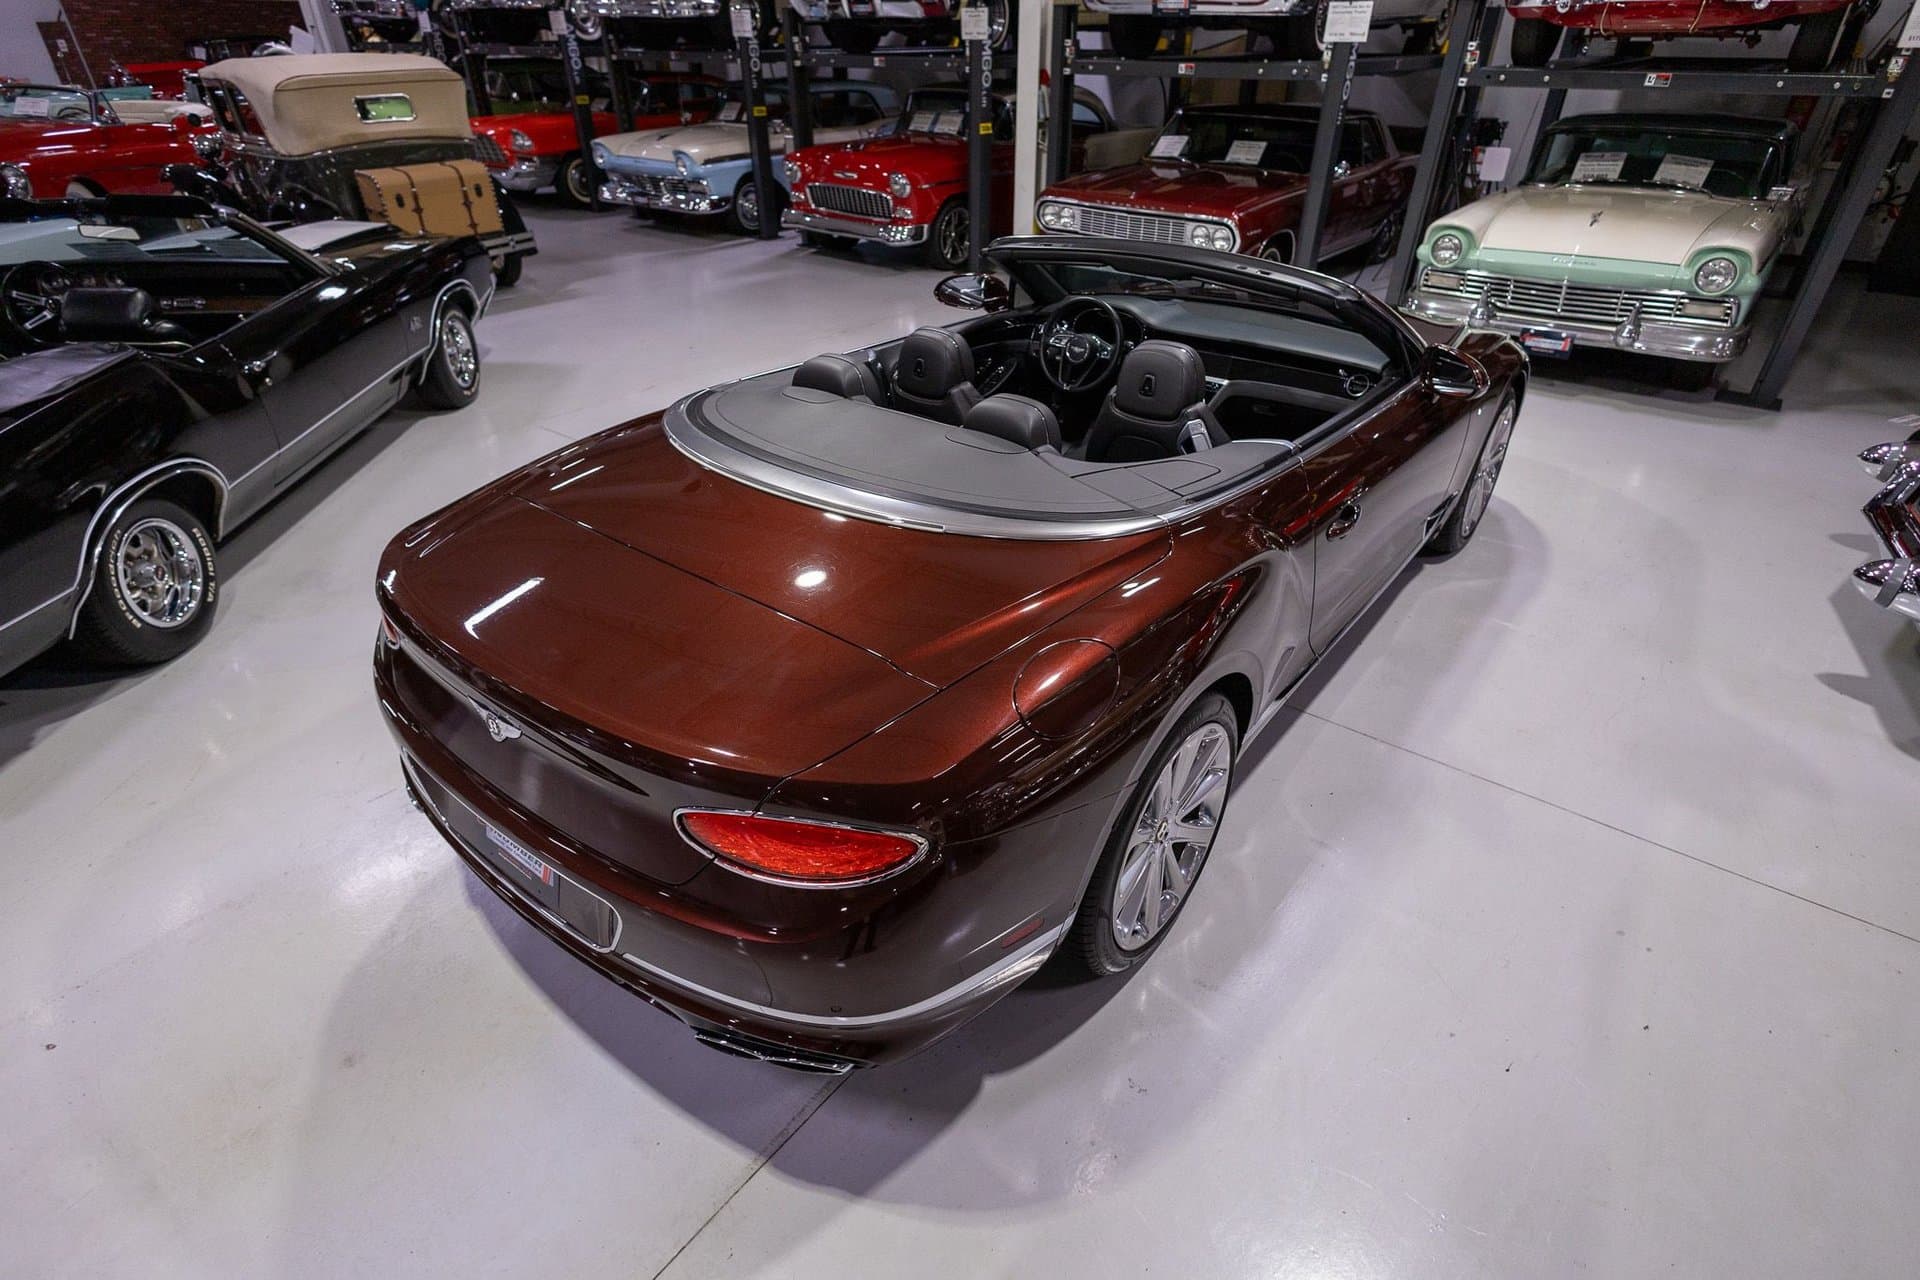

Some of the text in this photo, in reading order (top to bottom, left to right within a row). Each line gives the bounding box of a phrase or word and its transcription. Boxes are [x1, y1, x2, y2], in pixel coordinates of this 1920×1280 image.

[566, 23, 582, 70] AMGO
[192, 528, 216, 602] Radial T/A
